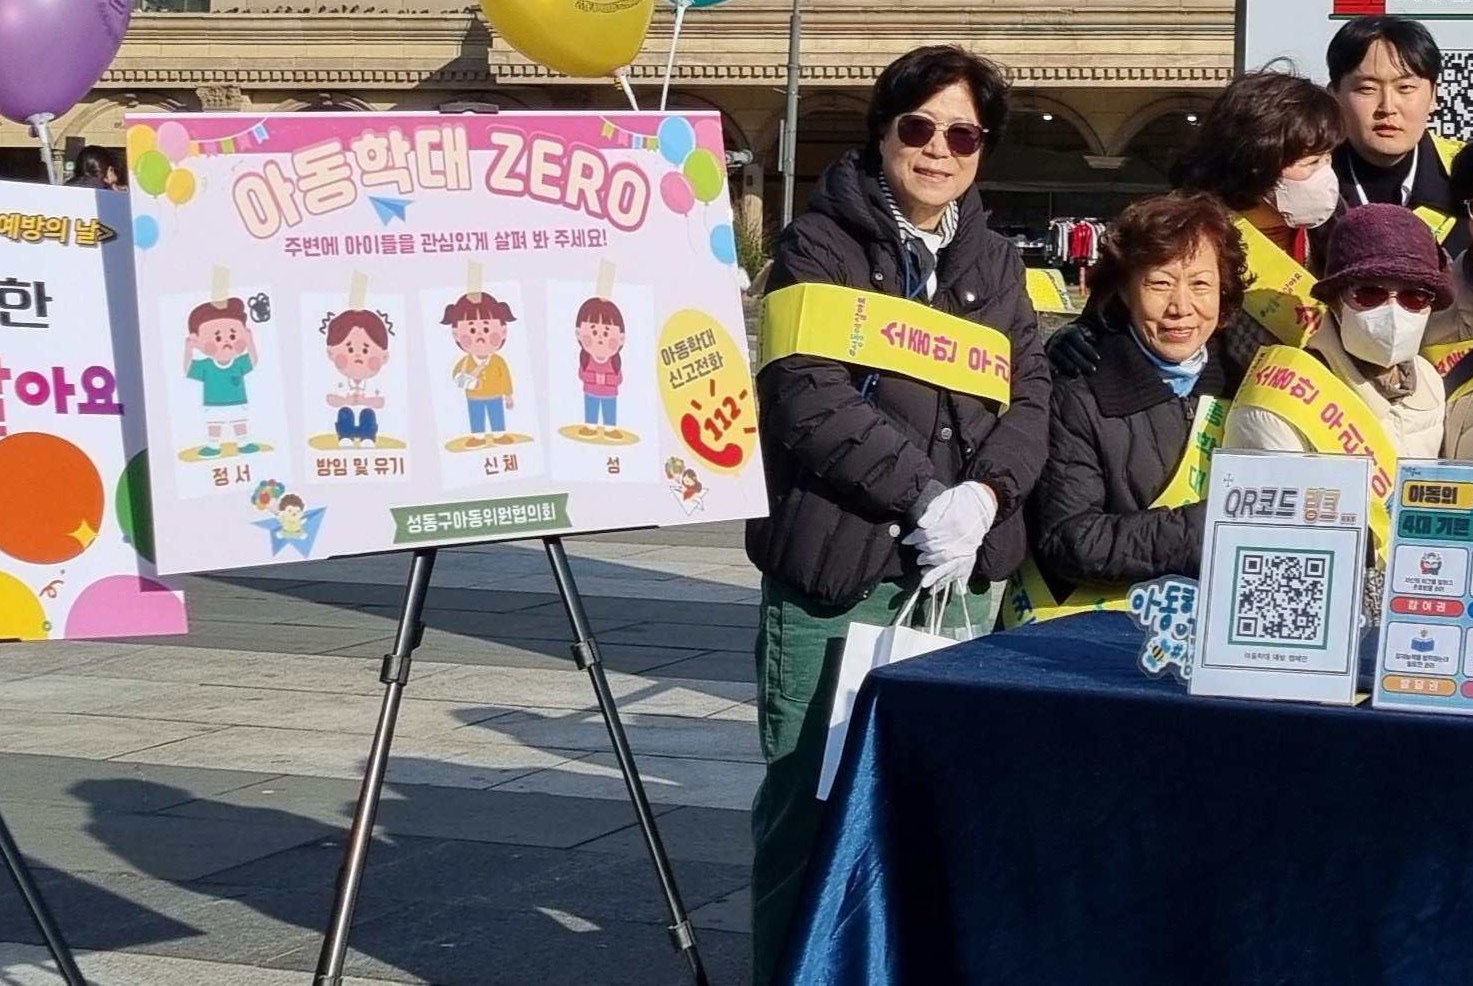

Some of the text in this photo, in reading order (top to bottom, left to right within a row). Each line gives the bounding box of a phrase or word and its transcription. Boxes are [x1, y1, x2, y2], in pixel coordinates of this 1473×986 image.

[232, 126, 651, 240] 아동학대 ZERO
[0, 213, 68, 245] 예방의
[284, 227, 608, 258] 주변에 아이들을 관심있게 살펴 봐 주세요!
[0, 278, 53, 329] 한
[661, 328, 718, 368] 아동학대
[880, 321, 958, 364] 소중한
[669, 352, 726, 390] 신고전화
[703, 394, 743, 441] 112
[212, 463, 251, 487] 정서
[316, 456, 405, 478] 방임 및 유기
[484, 453, 519, 477] 신체
[606, 455, 622, 475] 성
[1224, 488, 1298, 519] QR코드
[1408, 484, 1458, 505] 아동의
[406, 501, 557, 534] 성동구아동위원협의회
[1403, 517, 1431, 535] 4대
[1436, 518, 1470, 537] 기본
